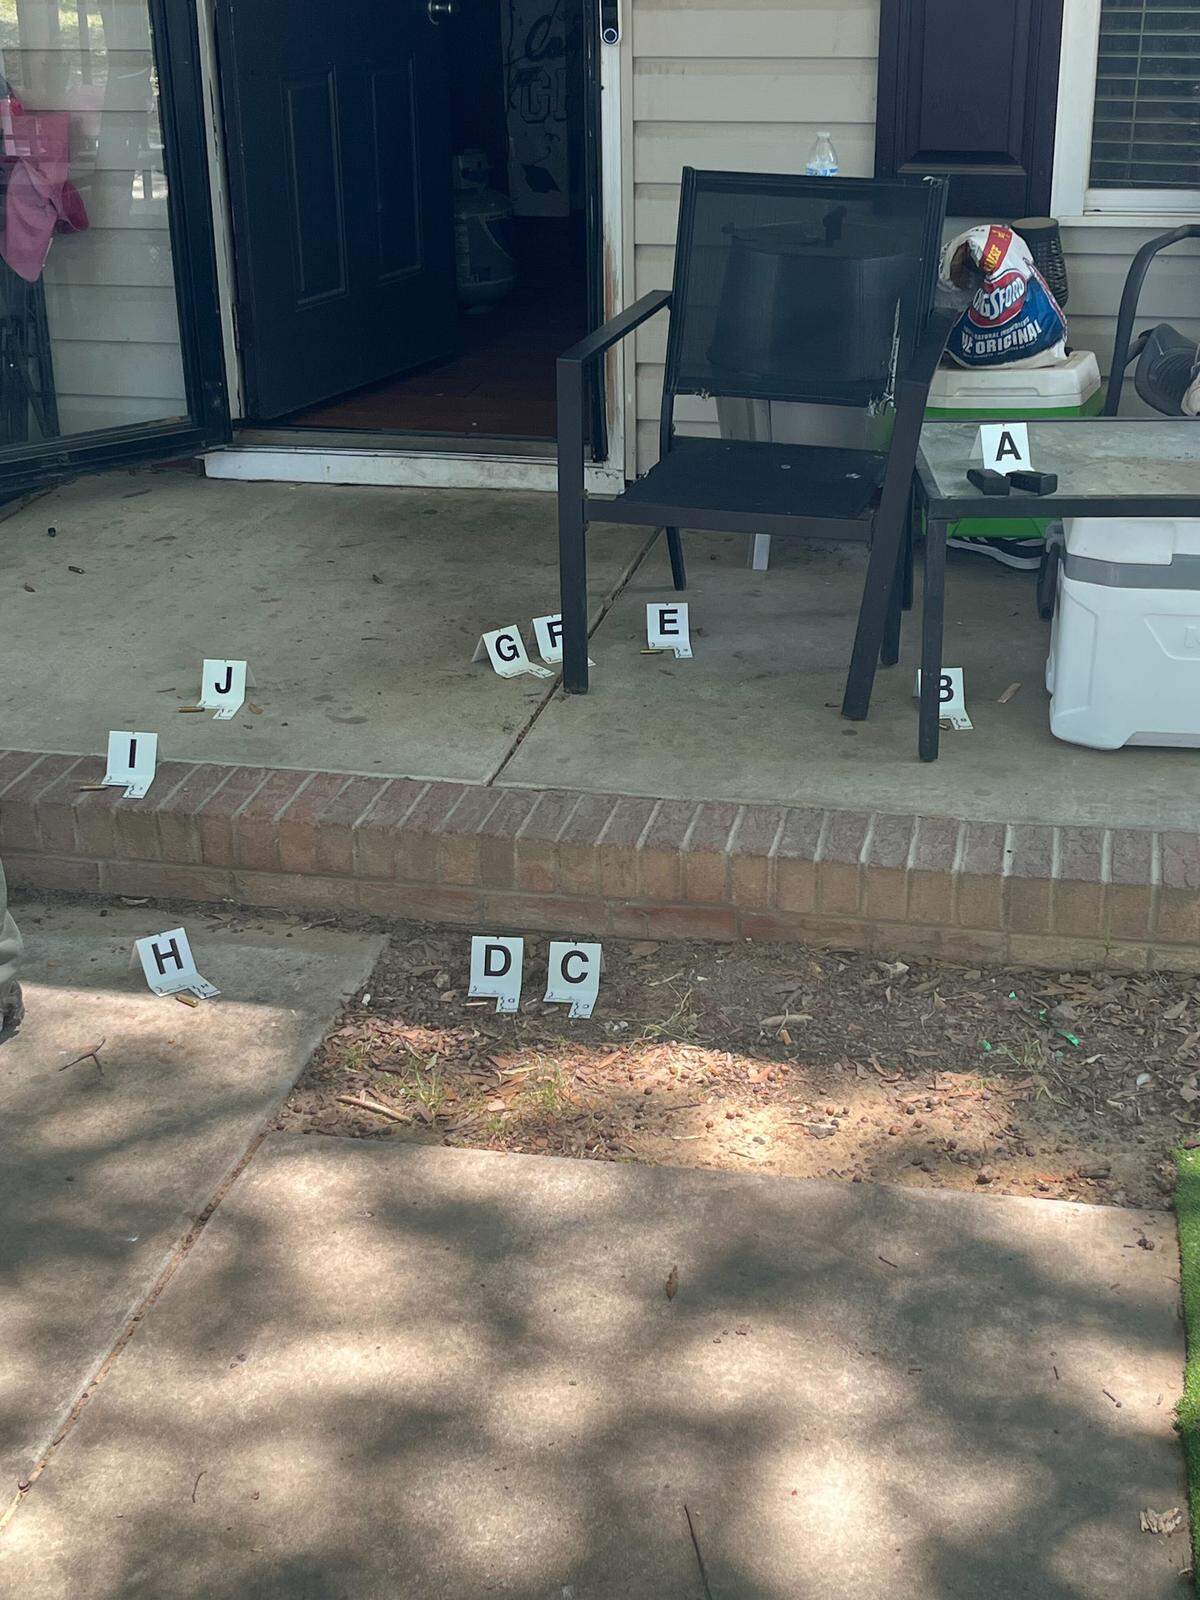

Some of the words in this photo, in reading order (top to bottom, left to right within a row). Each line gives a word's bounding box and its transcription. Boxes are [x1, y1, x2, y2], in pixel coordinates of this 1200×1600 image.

[995, 431, 1022, 461] A
[658, 608, 680, 635] E
[495, 634, 521, 662] G
[214, 666, 233, 694] J
[128, 738, 137, 769] I
[151, 938, 184, 975] H
[484, 944, 512, 977] D
[561, 950, 590, 984] C
